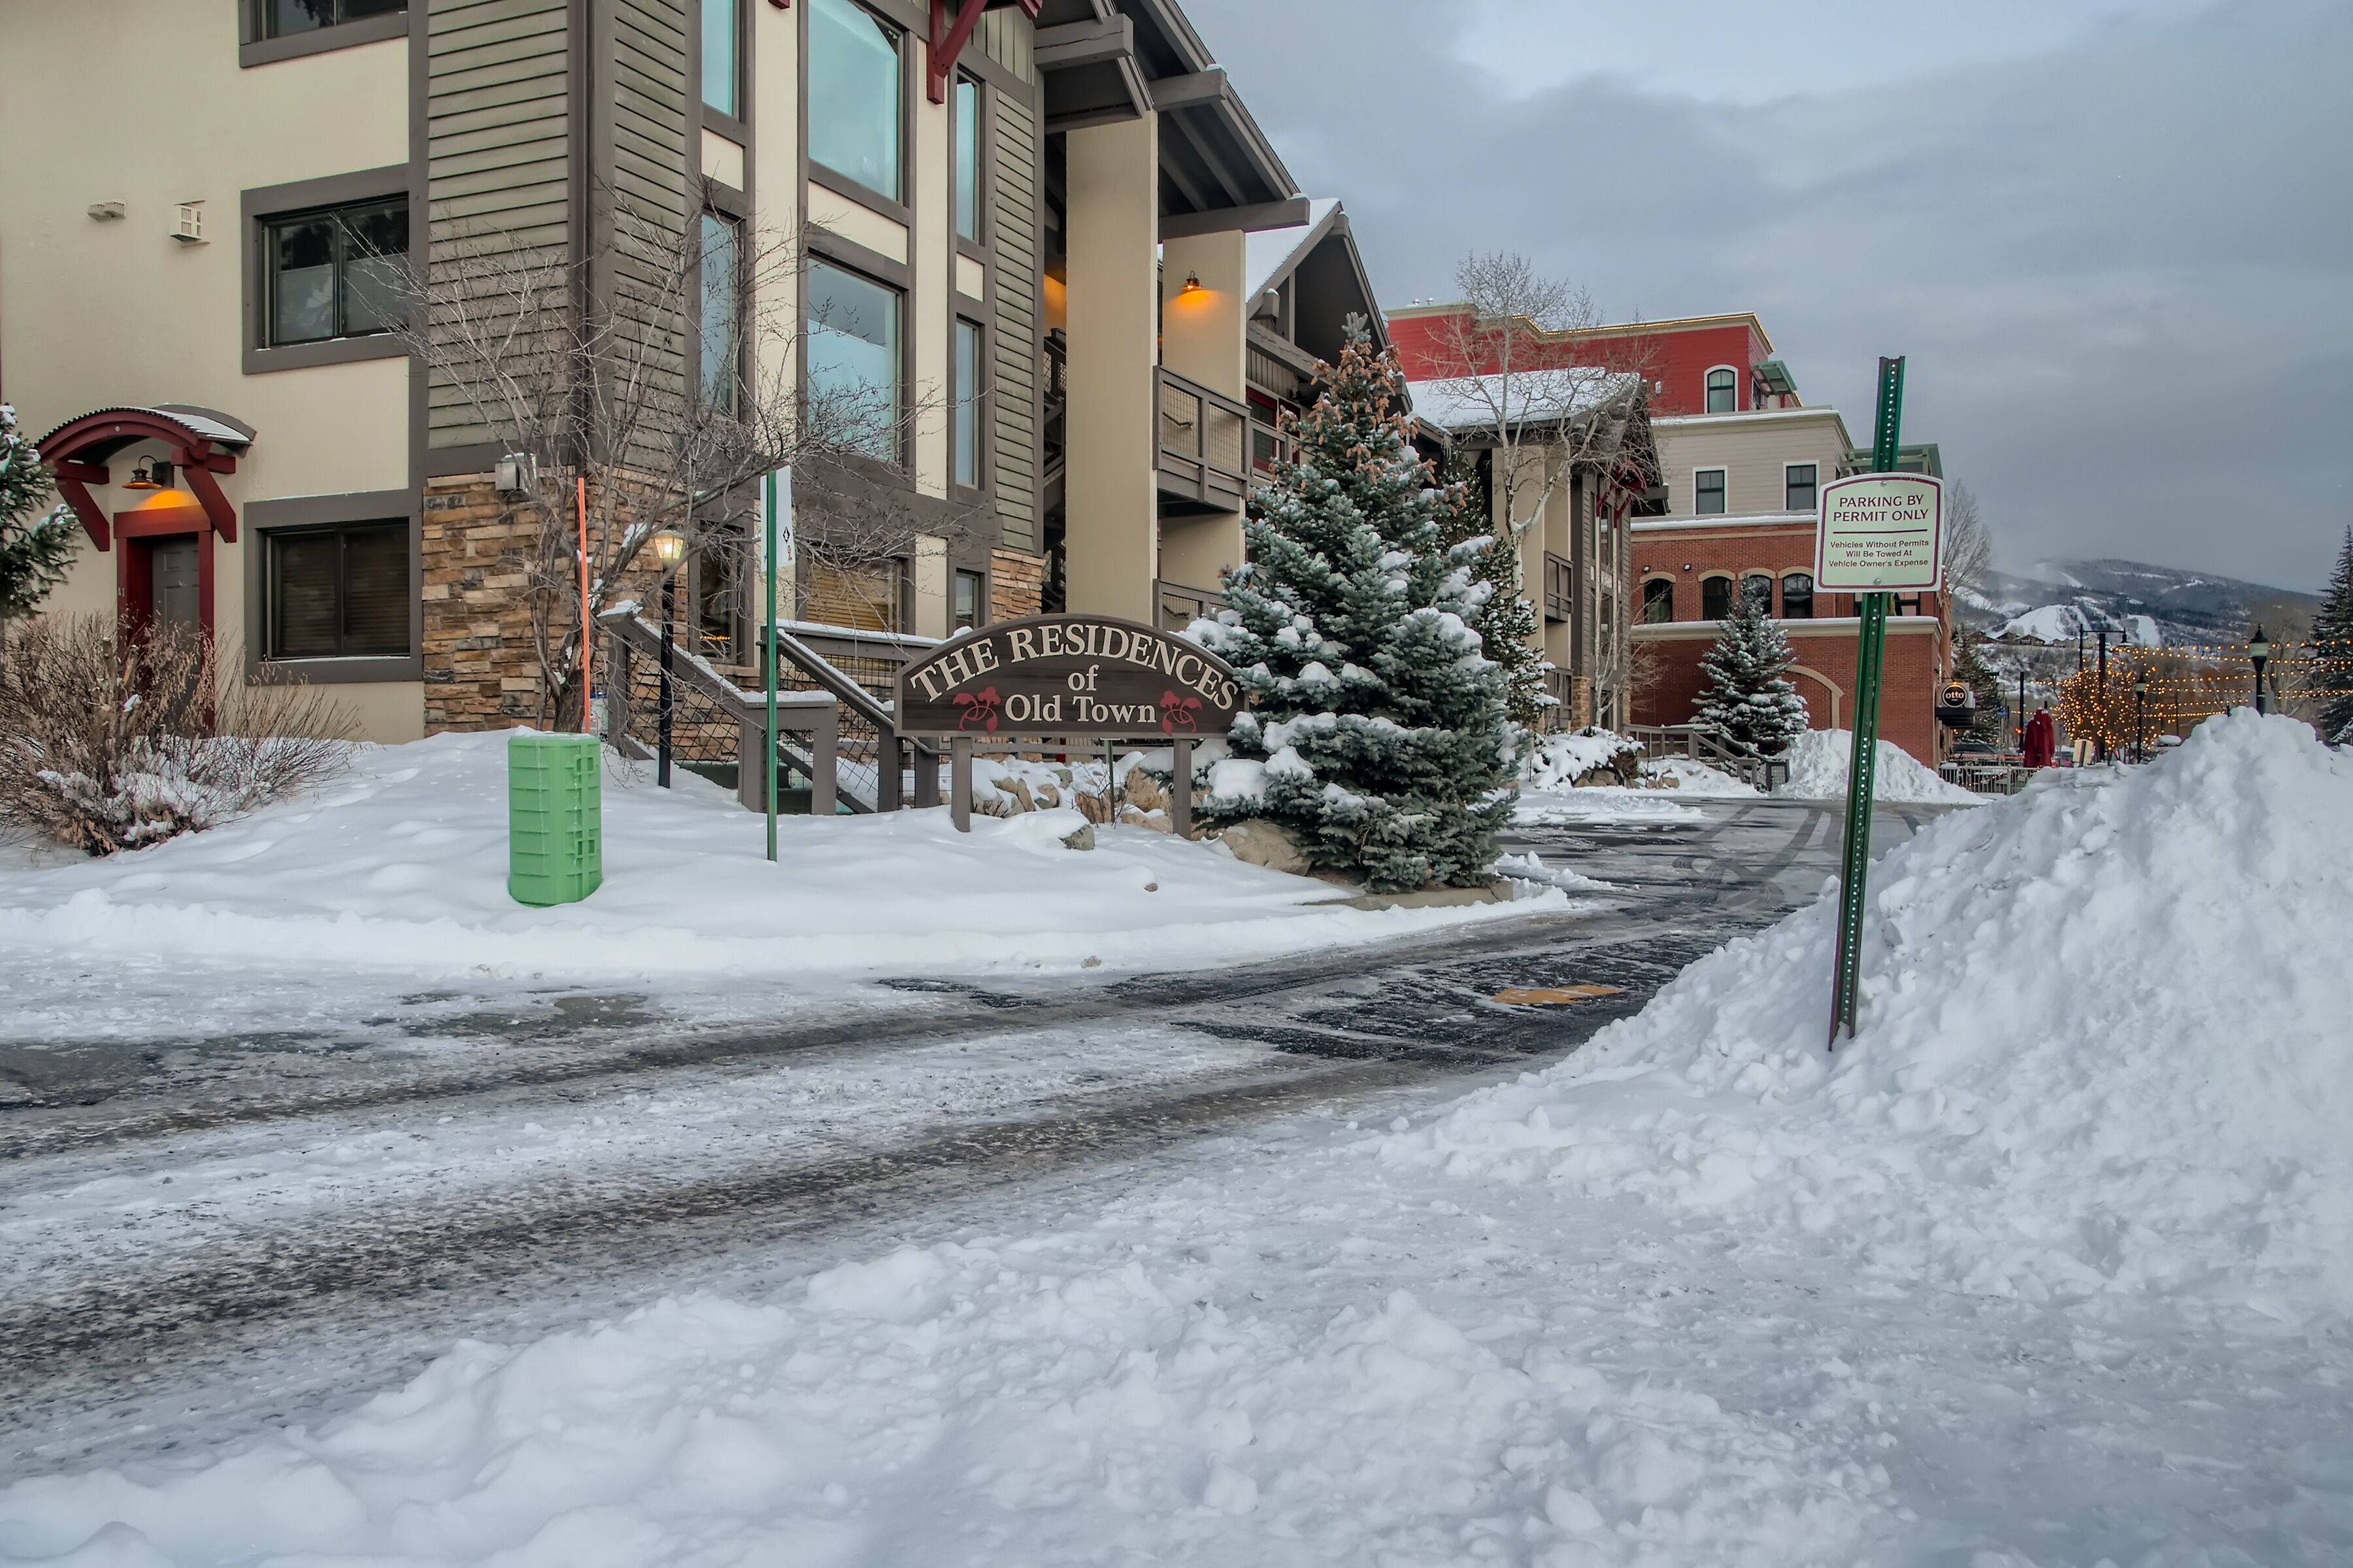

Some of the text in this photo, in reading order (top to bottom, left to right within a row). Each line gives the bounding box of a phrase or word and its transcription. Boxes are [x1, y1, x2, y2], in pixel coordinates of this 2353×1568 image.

[1839, 495, 1924, 507] PARKING BY
[1833, 509, 1929, 522] PERMIT ONLY
[1895, 559, 1928, 567] Expense
[910, 624, 1239, 710] THE RESIDENCES
[1067, 665, 1099, 691] of
[1005, 694, 1156, 723] Old Town
